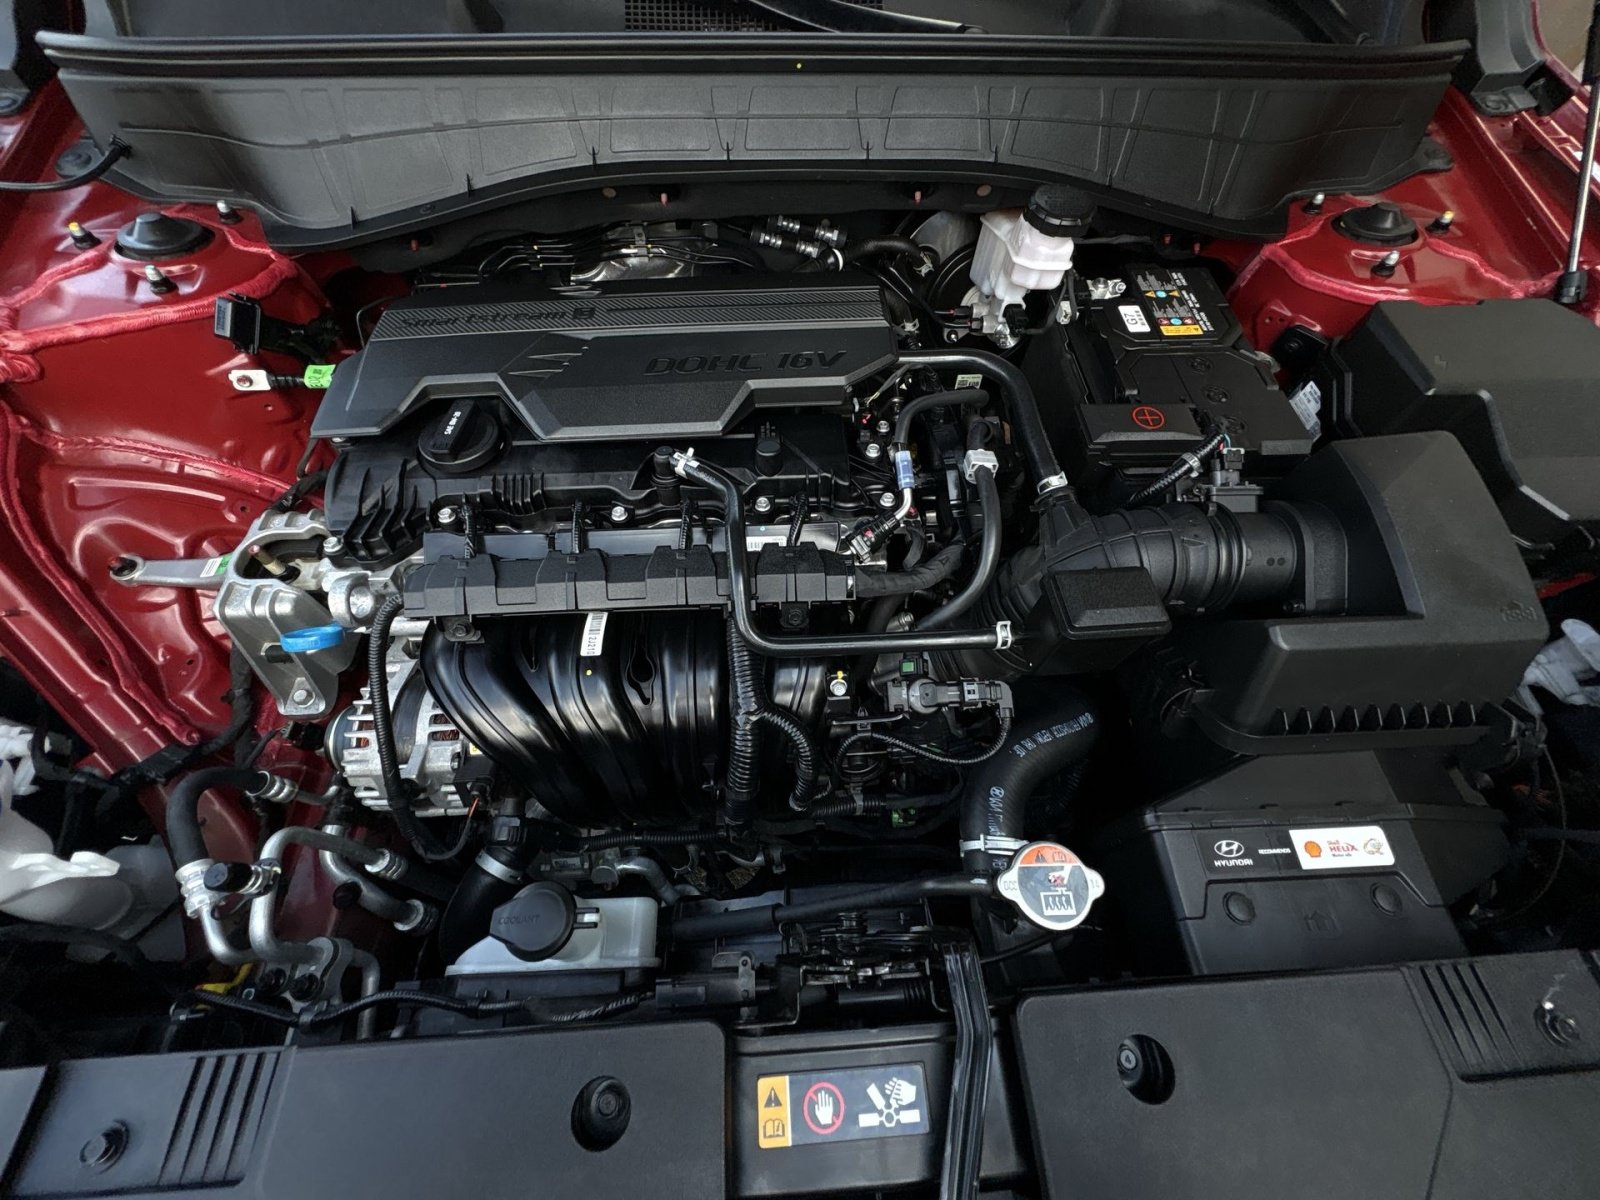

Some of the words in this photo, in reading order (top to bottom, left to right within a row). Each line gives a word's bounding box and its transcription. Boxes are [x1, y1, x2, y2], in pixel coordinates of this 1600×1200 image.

[402, 311, 566, 327] Smartstream
[642, 353, 767, 375] DOHC
[776, 350, 848, 371] 16V
[1329, 842, 1358, 852] HELIX
[1213, 858, 1253, 867] HYUNDAI
[498, 914, 541, 925] COOLANT
